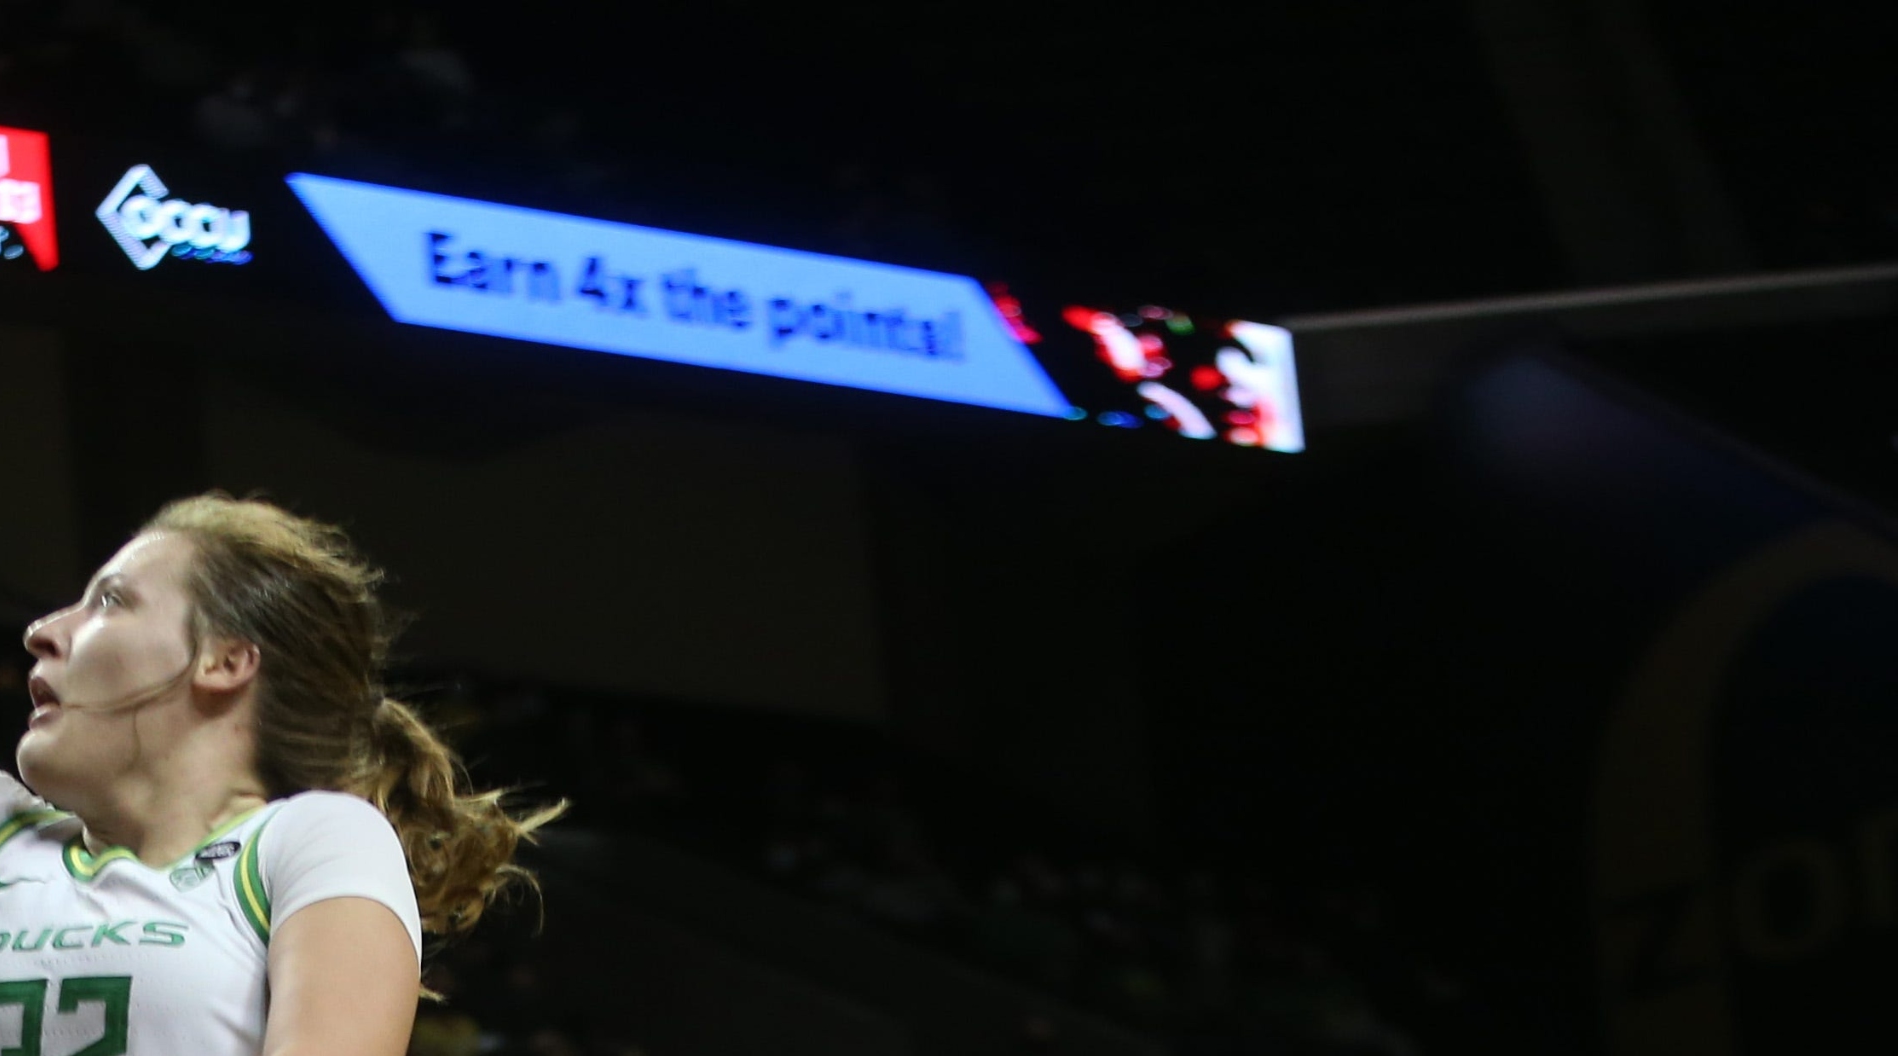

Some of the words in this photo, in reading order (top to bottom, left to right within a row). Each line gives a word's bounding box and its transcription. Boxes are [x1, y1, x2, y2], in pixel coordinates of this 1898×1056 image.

[427, 232, 561, 302] Earn
[578, 256, 648, 317] 4x
[661, 268, 752, 331] the
[768, 290, 968, 365] points!
